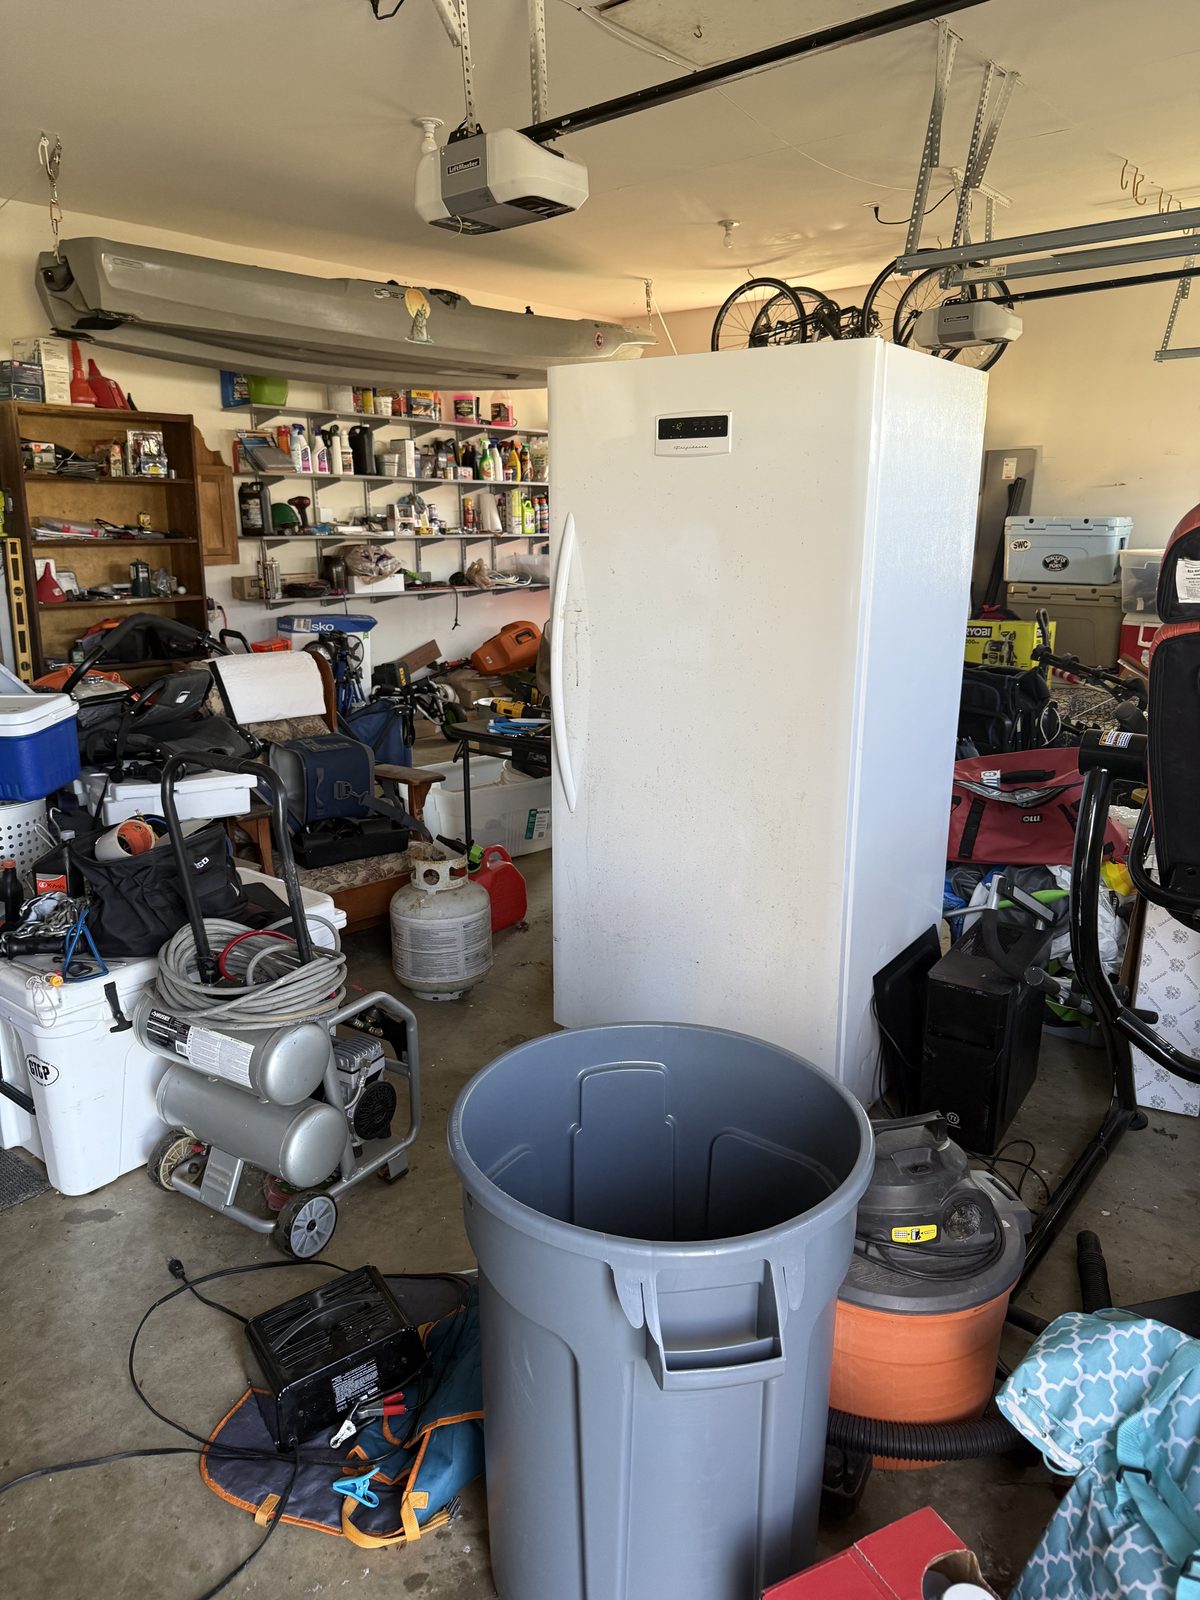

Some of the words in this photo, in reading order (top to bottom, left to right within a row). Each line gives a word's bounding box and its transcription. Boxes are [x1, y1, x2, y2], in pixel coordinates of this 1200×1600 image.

[448, 160, 478, 174] LiftMaster
[1013, 540, 1029, 550] SWC
[311, 621, 335, 632] sko
